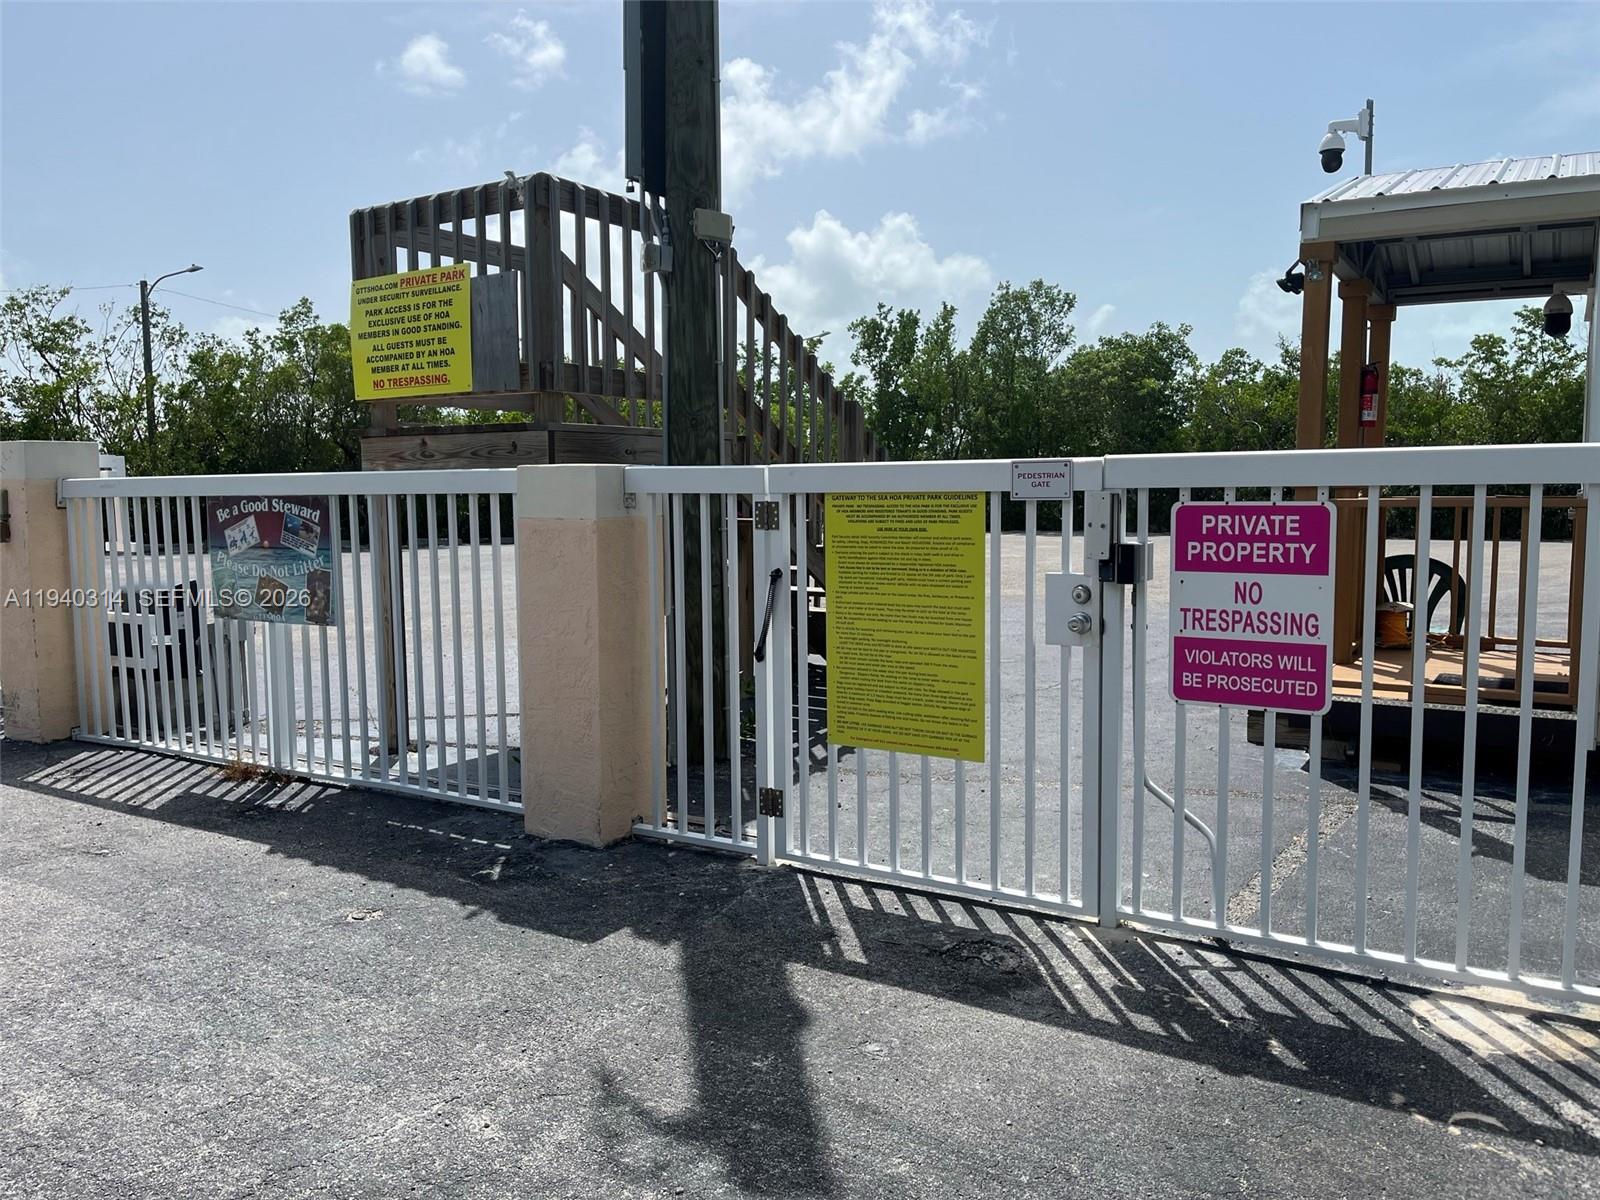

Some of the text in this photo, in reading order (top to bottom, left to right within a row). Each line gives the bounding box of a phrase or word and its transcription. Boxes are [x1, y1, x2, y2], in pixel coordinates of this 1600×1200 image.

[356, 269, 465, 295] GTTSHOA.COM PRIVATE PARK
[358, 284, 462, 305] UNDER SECURITY SURVEILLANCE.
[365, 309, 383, 317] PARK
[384, 304, 411, 316] ACCESS
[422, 301, 437, 310] FOR
[439, 298, 453, 308] THE
[368, 316, 405, 328] EXCLUSIVE
[407, 315, 421, 323] USE
[434, 310, 450, 319] HOA
[358, 328, 390, 340] MEMBERS
[401, 325, 421, 335] GOOD
[423, 321, 462, 332] STANDING.
[366, 352, 414, 364] ACCOMPANIED
[428, 349, 437, 357] AN
[440, 347, 455, 356] HOA
[372, 337, 447, 352] ALL GUESTS MUST BE
[371, 360, 450, 374] MEMBER AT ALL TIMES.
[373, 374, 451, 389] NO TRESPASSING.
[216, 498, 320, 523] Be a Good Steward
[1201, 514, 1300, 536] PRIVATE
[1186, 541, 1317, 564] PROPERTY
[216, 551, 324, 578] Please Do Not Litter
[1234, 581, 1263, 605] NO
[1180, 607, 1320, 637] TRESPASSING
[1184, 648, 1317, 672] VIOLATORS WILL
[1182, 672, 1318, 697] BE PROSECUTED
